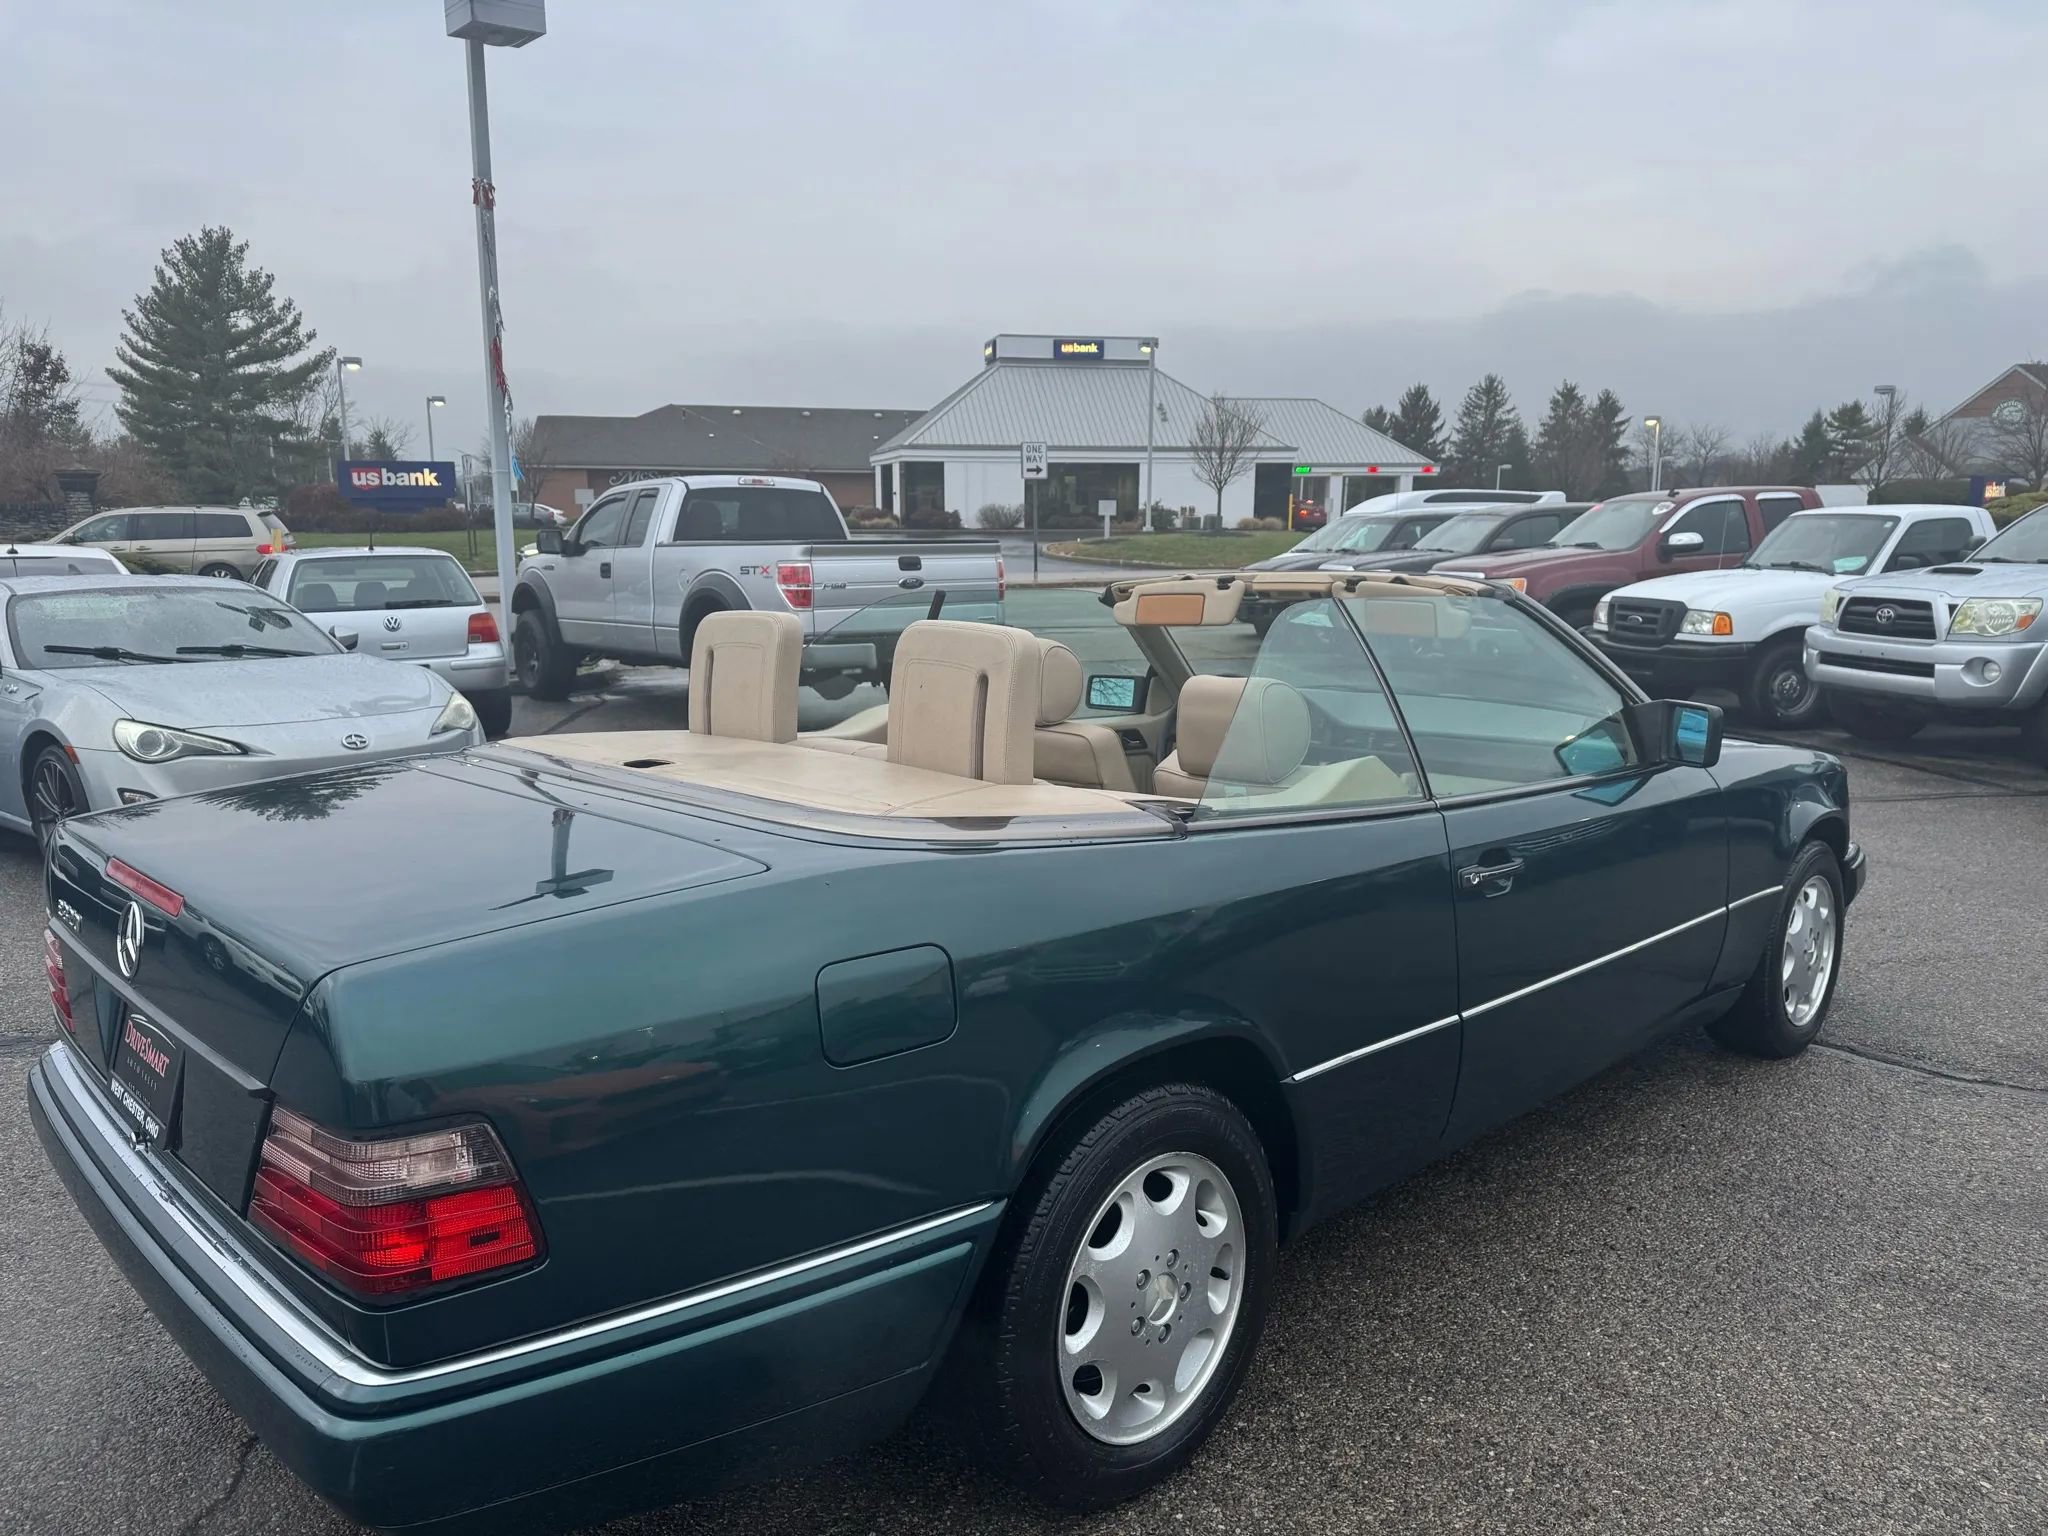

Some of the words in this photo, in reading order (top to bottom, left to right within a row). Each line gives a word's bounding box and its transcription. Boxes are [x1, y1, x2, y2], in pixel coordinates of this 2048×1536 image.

[1026, 444, 1043, 454] ONE
[1026, 454, 1043, 463] WAY
[740, 566, 769, 575] STX
[110, 1077, 124, 1101] WEST
[122, 1091, 146, 1128] CHESTER,
[145, 1116, 159, 1139] OHIO
